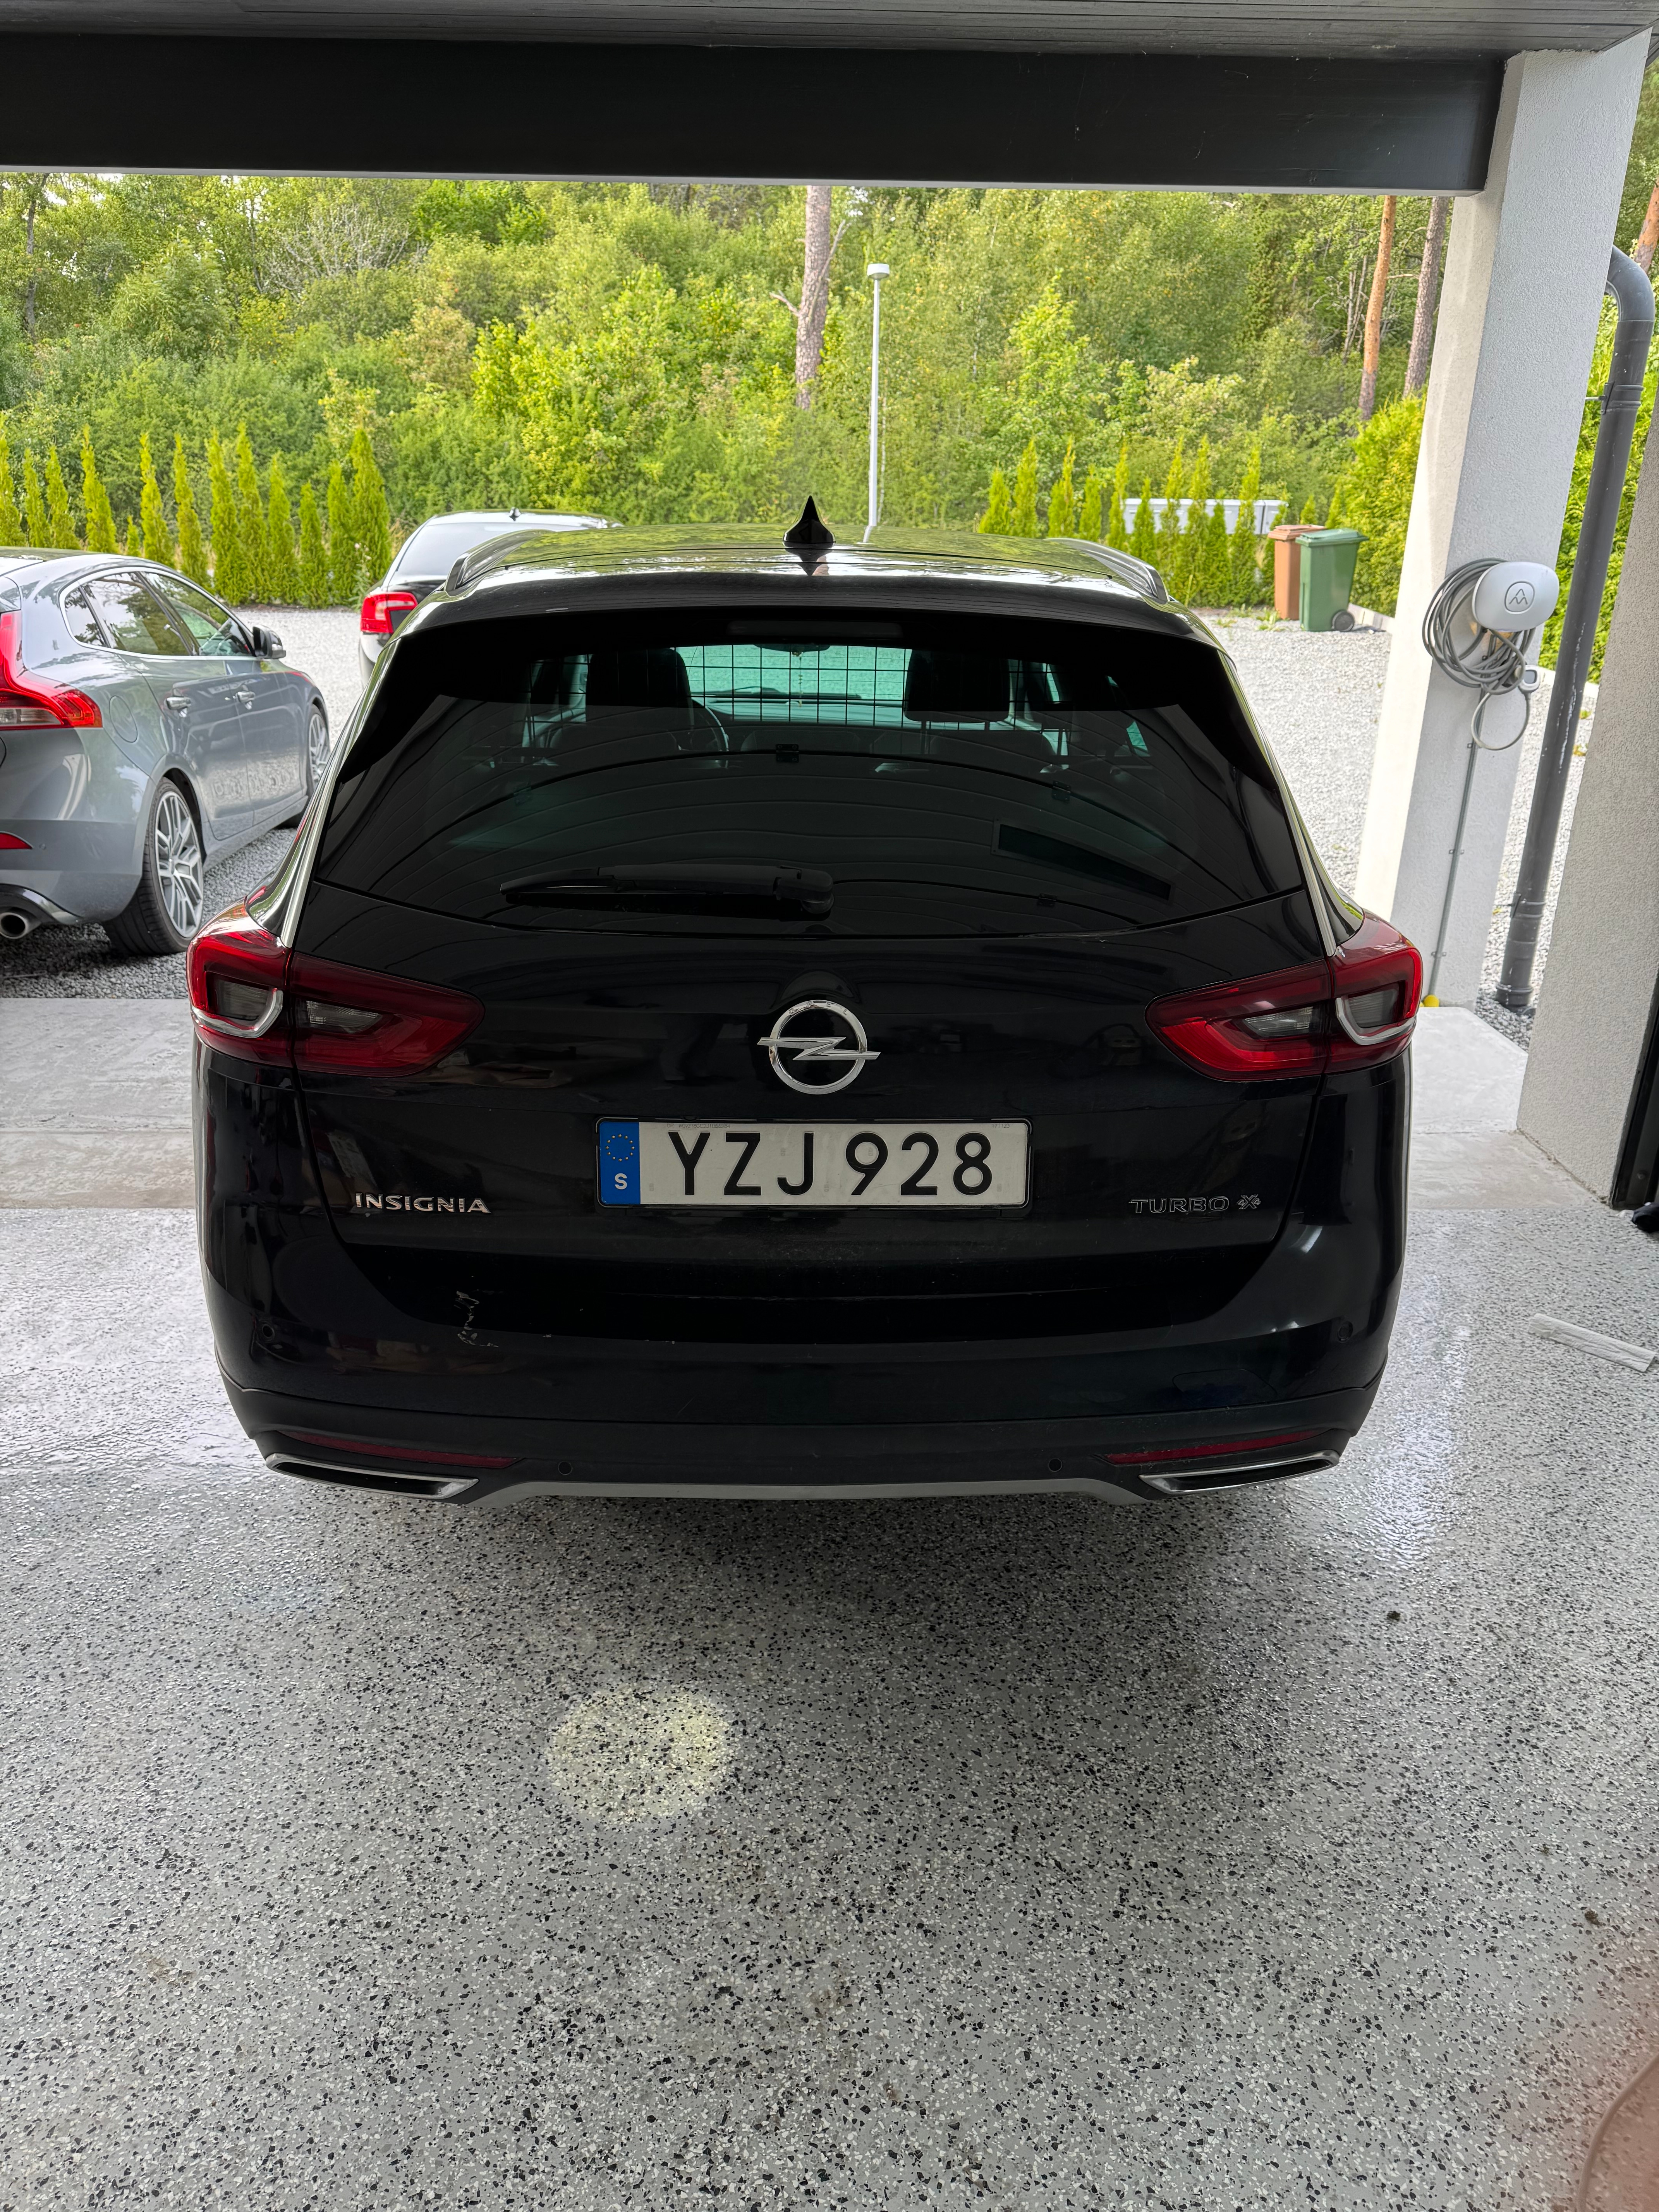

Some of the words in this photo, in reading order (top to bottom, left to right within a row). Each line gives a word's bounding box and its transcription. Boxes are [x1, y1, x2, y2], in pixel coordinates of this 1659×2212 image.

[788, 1000, 847, 1015] OPEL
[668, 1132, 814, 1195] YZJ
[845, 1132, 992, 1195] 928
[615, 1173, 627, 1190] S
[356, 1193, 491, 1214] INSIGNIA
[1128, 1196, 1229, 1214] TURBO
